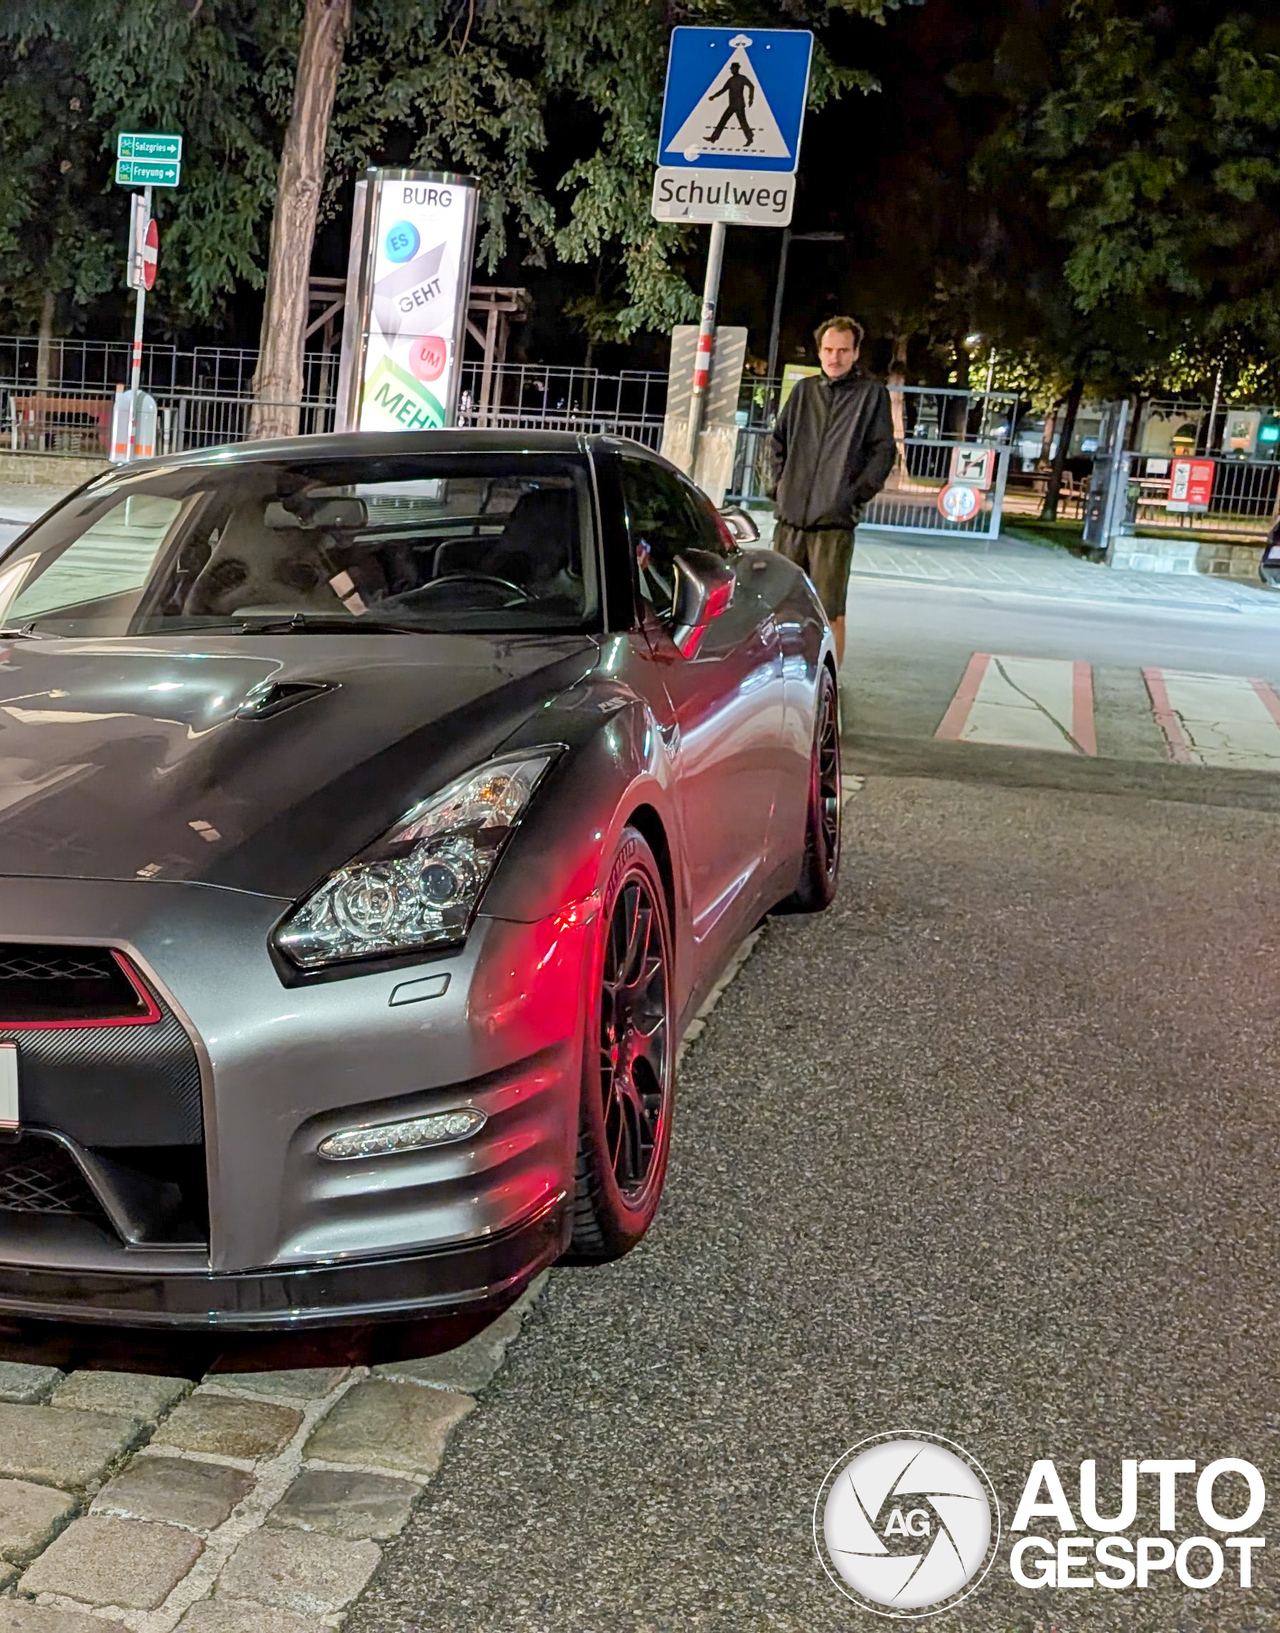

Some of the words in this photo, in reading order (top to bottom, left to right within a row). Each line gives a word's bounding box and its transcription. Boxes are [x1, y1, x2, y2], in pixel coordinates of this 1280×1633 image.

[135, 141, 166, 154] Salzgries
[133, 165, 164, 179] Freyung
[403, 187, 452, 208] BURG
[659, 178, 788, 213] Schulweg
[390, 233, 409, 252] ES
[398, 278, 444, 314] GEHT
[420, 348, 440, 369] UM
